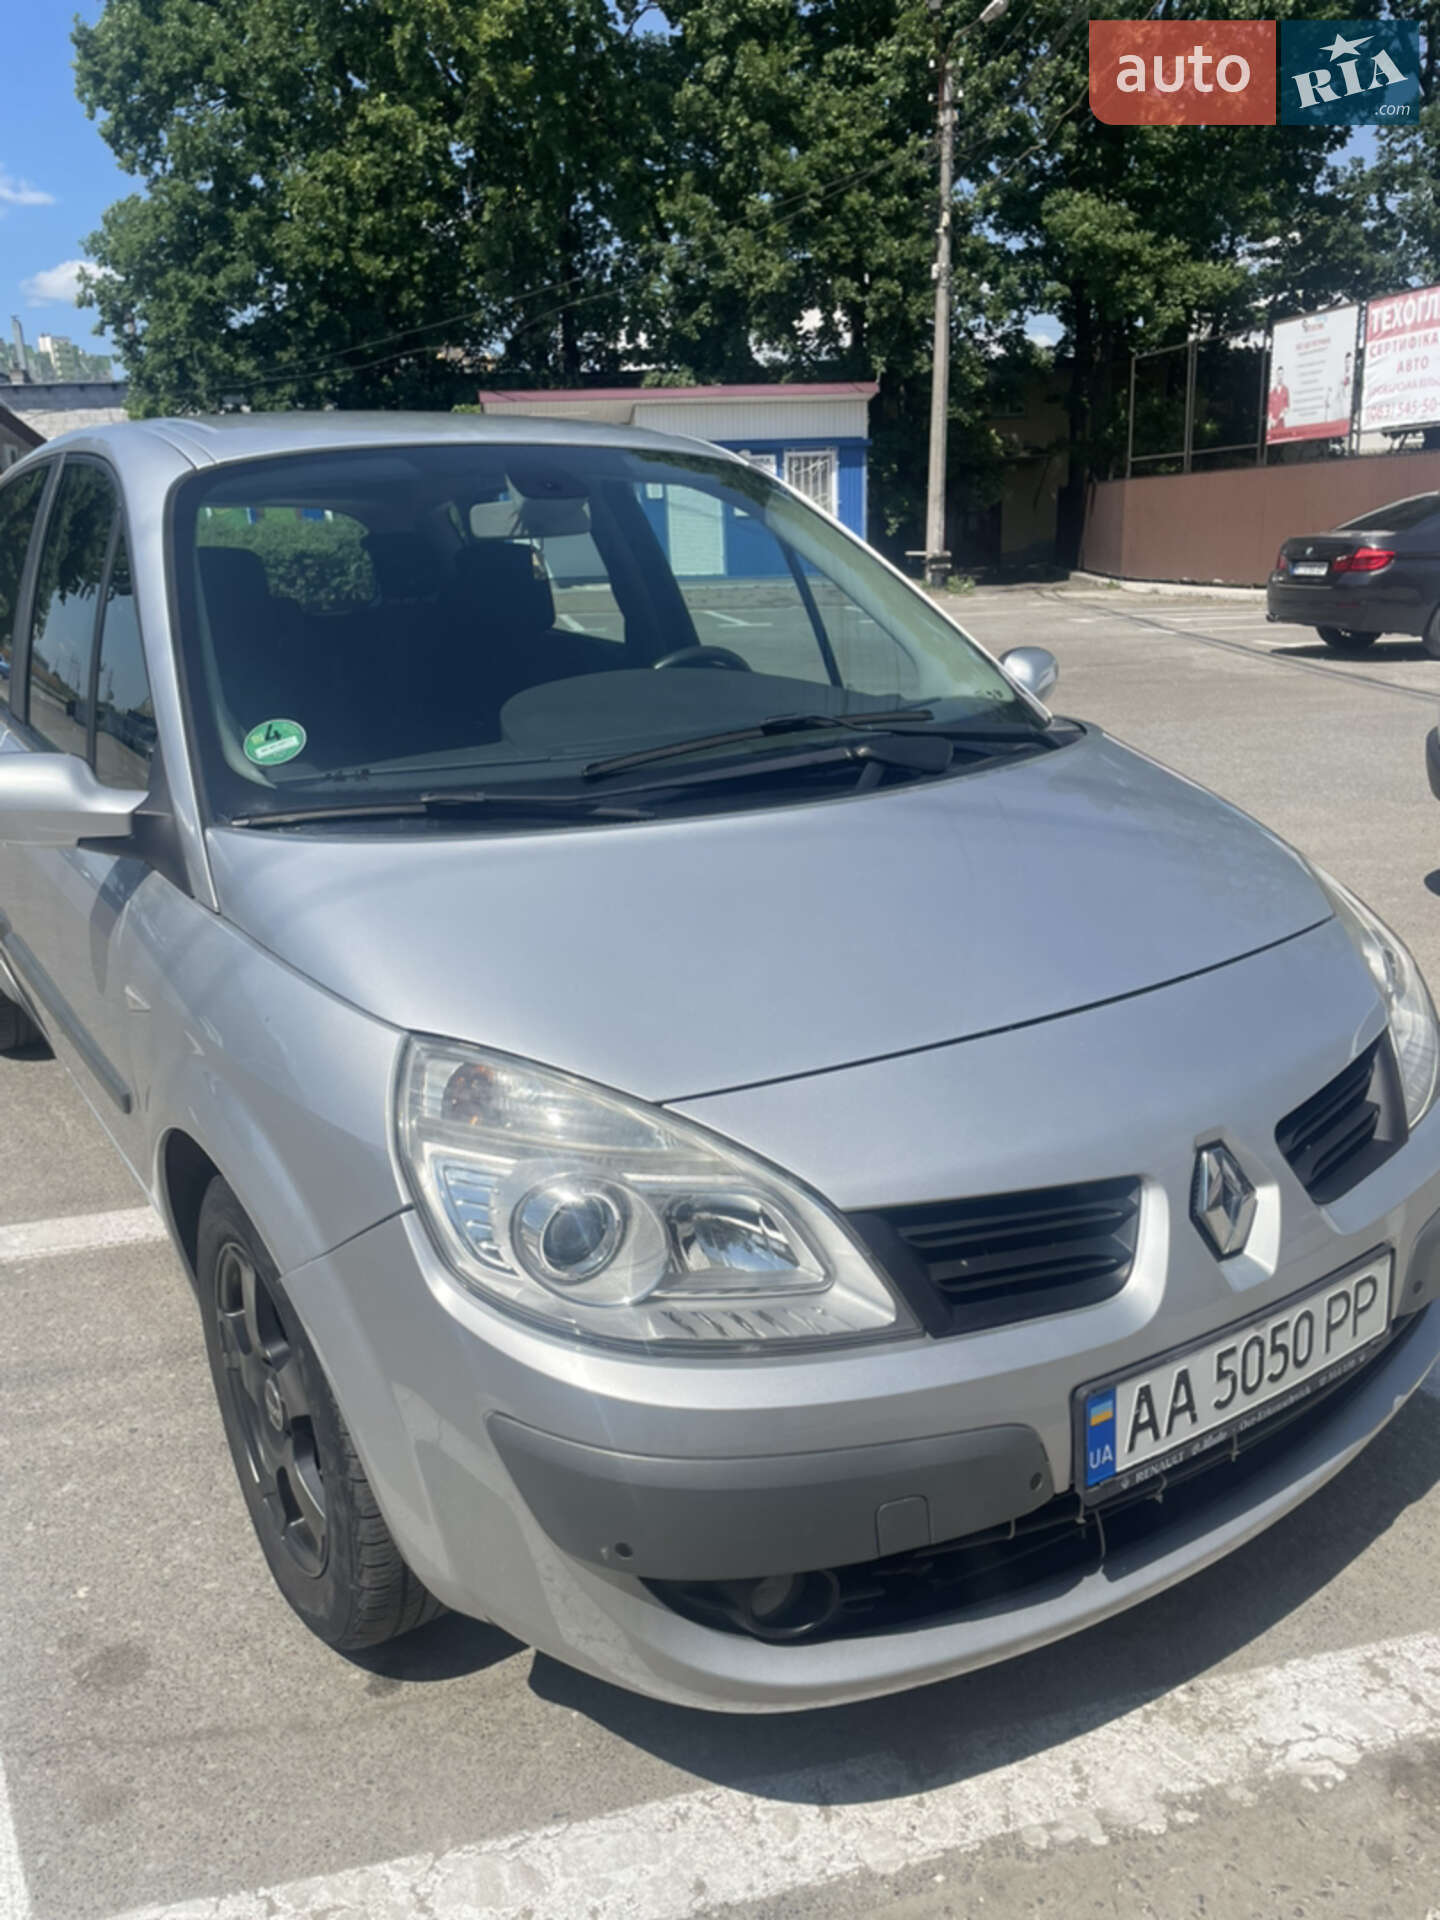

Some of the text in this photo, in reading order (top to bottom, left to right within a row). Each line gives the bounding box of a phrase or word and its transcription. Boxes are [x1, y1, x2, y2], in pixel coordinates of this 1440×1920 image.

[1396, 355, 1429, 374] АВТО
[1127, 1366, 1198, 1453] AA
[1213, 1309, 1315, 1411] 5050
[1325, 1274, 1378, 1354] PP
[1089, 1444, 1114, 1469] UA
[1134, 1451, 1186, 1484] RENAULT
